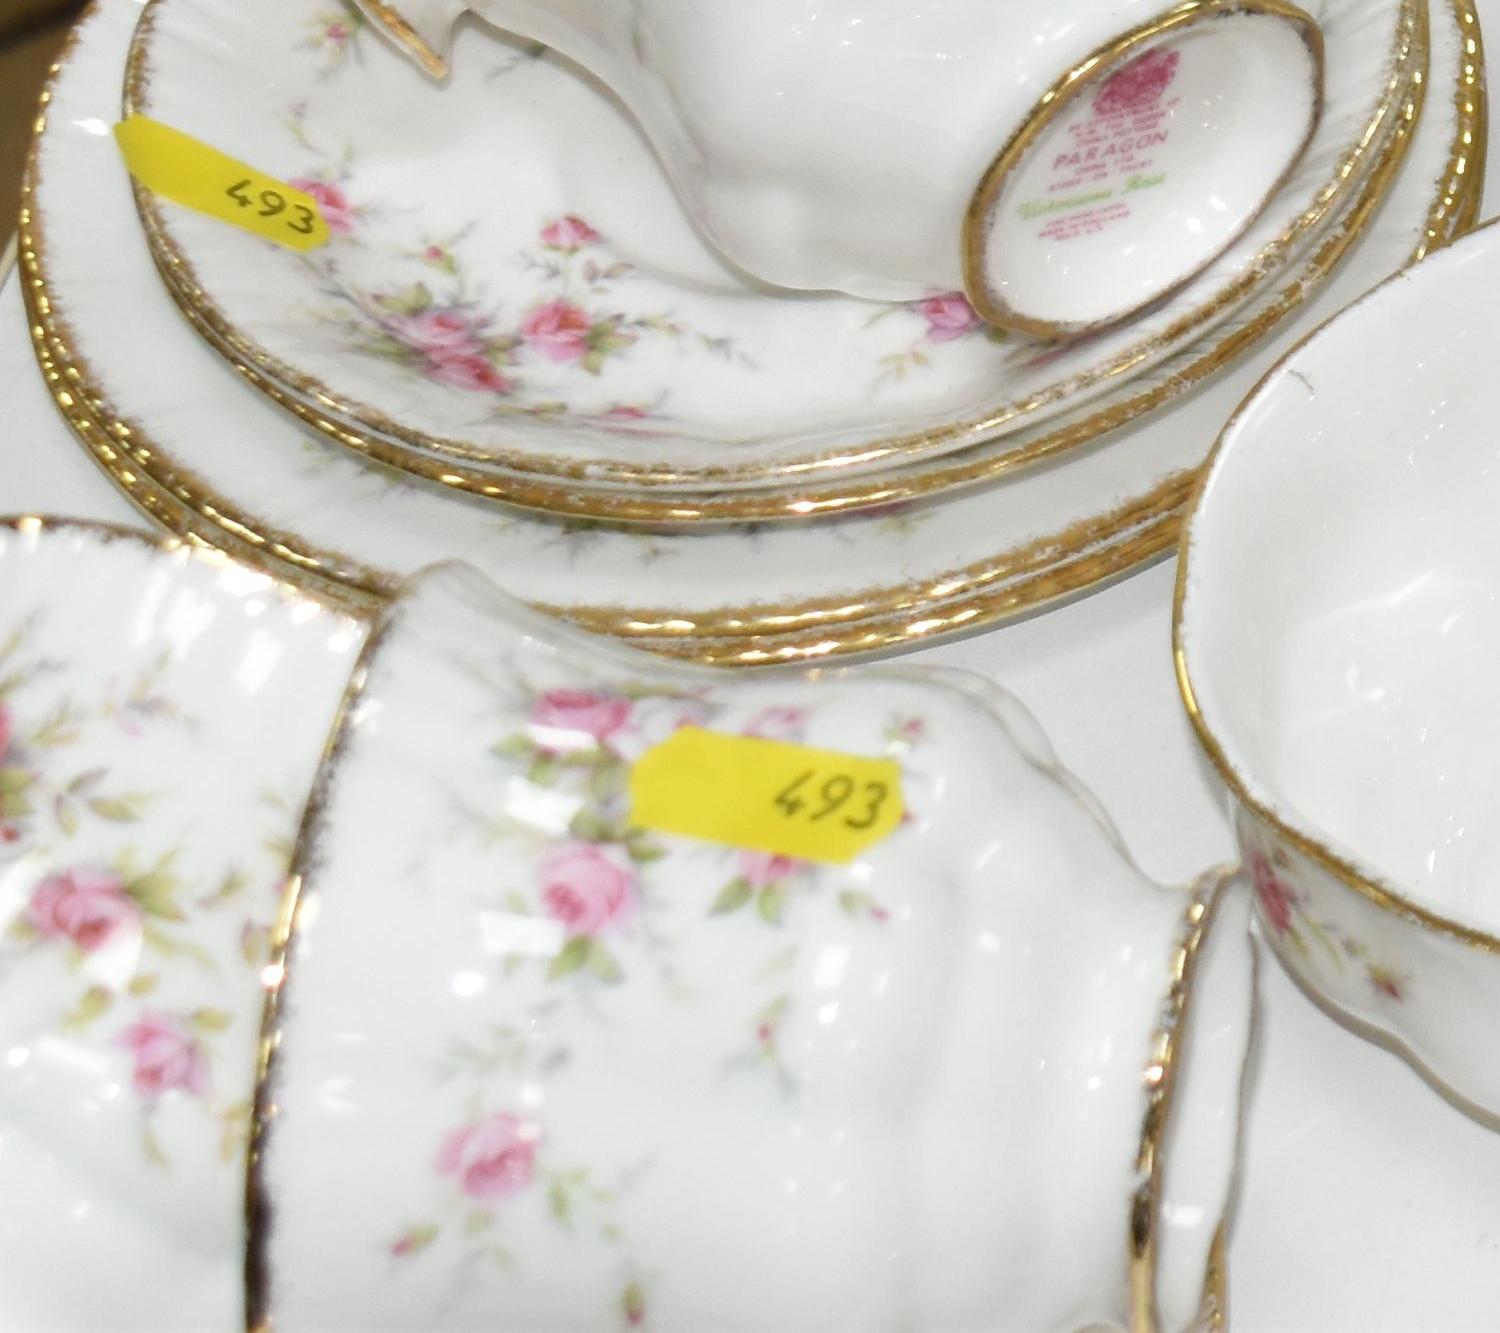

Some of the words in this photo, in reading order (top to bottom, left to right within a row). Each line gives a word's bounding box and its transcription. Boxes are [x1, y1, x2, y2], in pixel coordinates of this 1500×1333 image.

[1053, 129, 1169, 171] PARAGON
[224, 178, 315, 236] 493
[773, 769, 890, 831] 493
